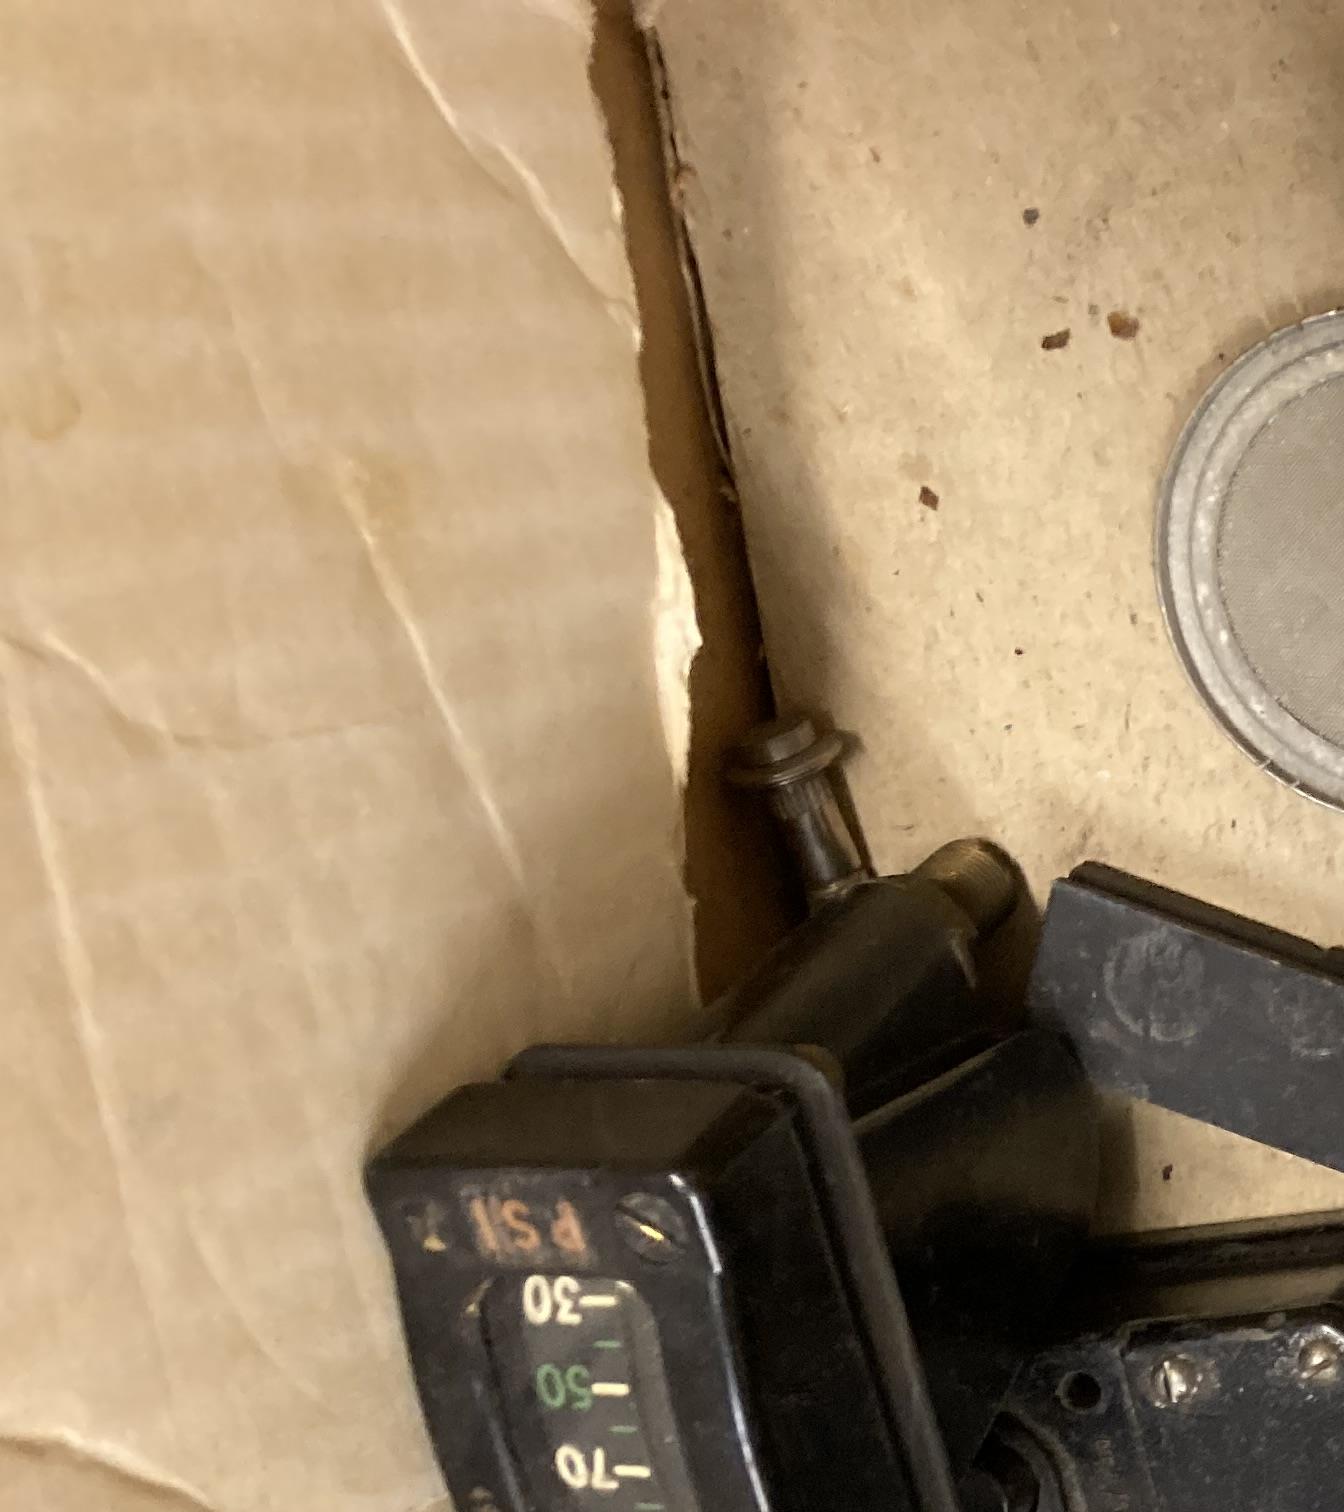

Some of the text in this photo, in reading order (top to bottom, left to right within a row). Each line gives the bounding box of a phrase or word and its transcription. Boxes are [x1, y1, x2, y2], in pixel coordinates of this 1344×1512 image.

[467, 1200, 591, 1261] PSI
[523, 1275, 582, 1325] 30
[536, 1364, 593, 1410] 50
[554, 1447, 620, 1490] 70
